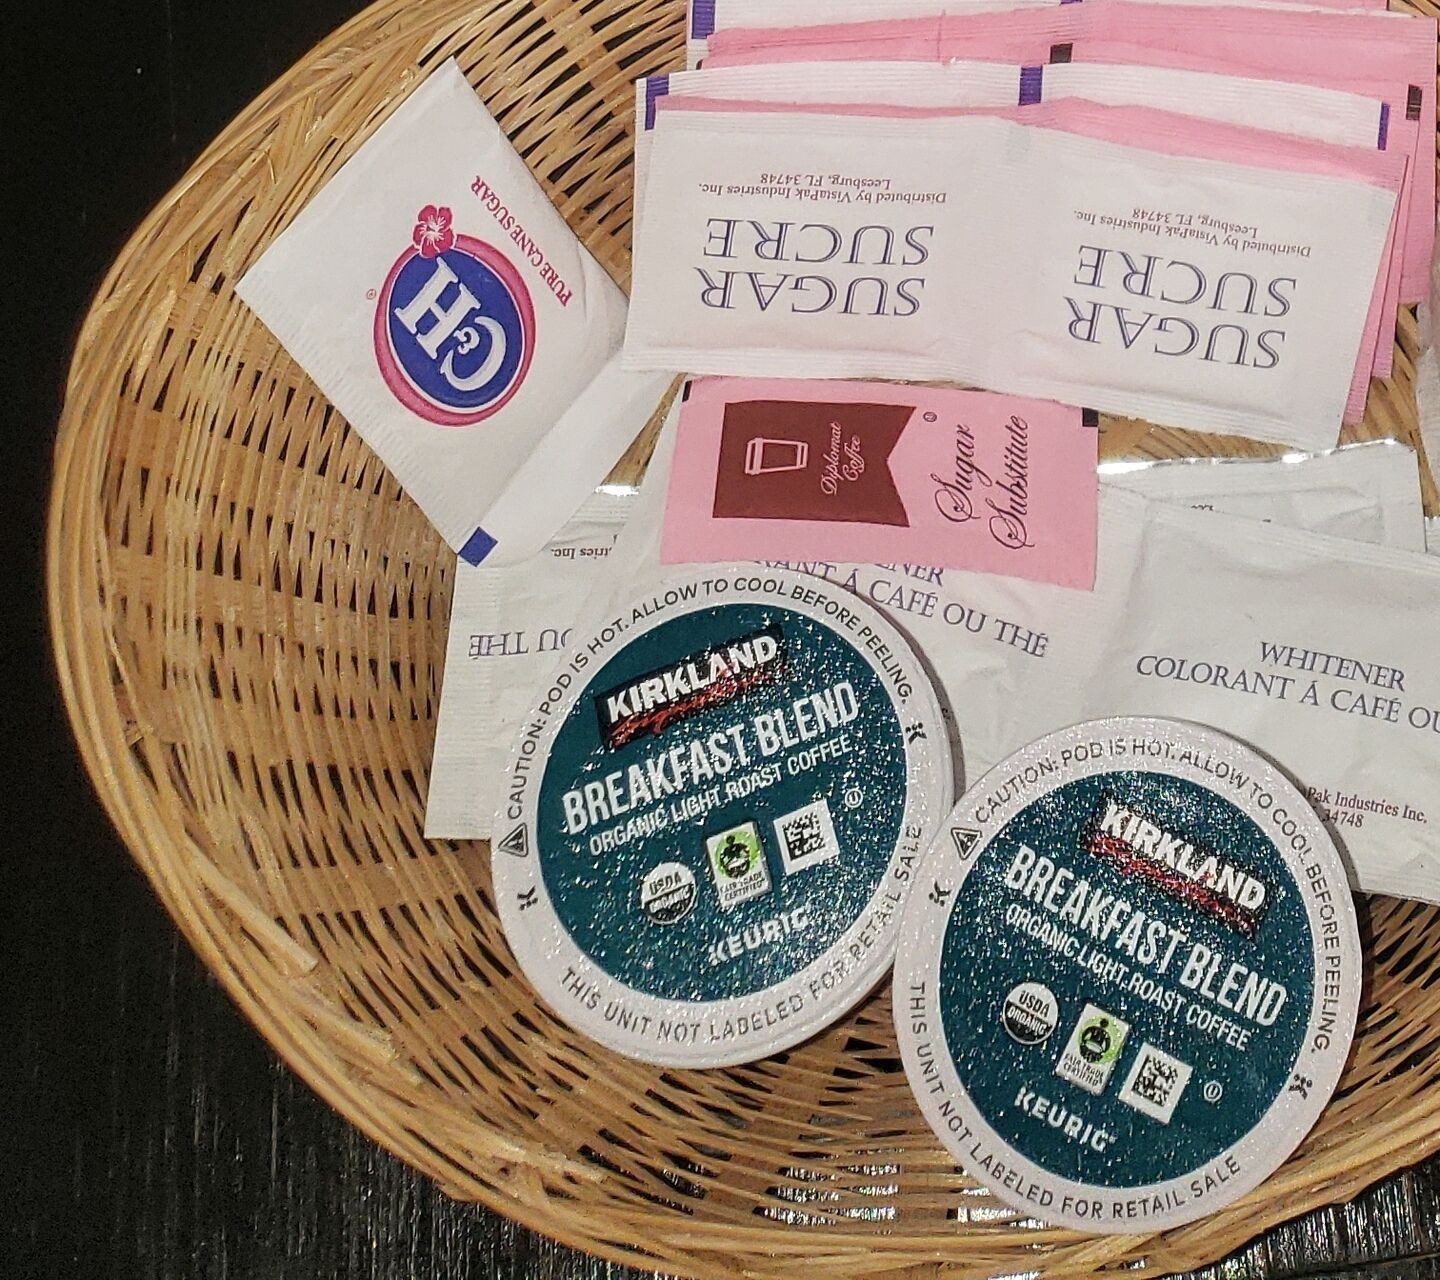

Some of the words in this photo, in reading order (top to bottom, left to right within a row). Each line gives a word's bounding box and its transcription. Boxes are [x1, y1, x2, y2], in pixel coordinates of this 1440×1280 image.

[470, 174, 516, 231] SUGAR
[697, 181, 725, 197] Inc.
[727, 183, 793, 200] Industries
[760, 172, 801, 186] 34748
[795, 188, 853, 204] VistaPak
[803, 173, 824, 188] FL
[855, 190, 874, 205] by
[875, 190, 948, 205] Distributed
[1073, 208, 1097, 226] Inc.
[1099, 215, 1162, 237] Industries
[1131, 208, 1170, 226] 34748
[1165, 224, 1221, 247] VistaPak
[1175, 212, 1195, 227] FL
[509, 224, 545, 268] CANE
[703, 217, 935, 267] SUCRE
[1222, 235, 1240, 252] by
[1242, 239, 1313, 259] Distributed
[539, 261, 573, 307] PURE
[692, 266, 926, 318] SUGAR
[1073, 244, 1298, 318] SUCRE
[394, 255, 507, 392] C&H
[1062, 295, 1287, 370] SUGAR
[820, 421, 844, 497] Diplomat
[842, 433, 865, 481] Coffee
[929, 423, 993, 523] Sugar
[984, 414, 1036, 550] Substitute
[551, 546, 576, 560] Inc.
[868, 579, 939, 619] CAFÉ
[943, 602, 987, 633] OU
[994, 618, 1050, 659] THÉ
[606, 633, 778, 725] KIRKLAND
[1136, 654, 1296, 701] COLORANT
[1330, 689, 1403, 724] CAFÉ
[1259, 641, 1406, 692] WHITENER
[507, 718, 548, 821] CAUTION:
[538, 672, 573, 717] POD
[570, 652, 590, 674] IS
[587, 617, 630, 657] HOT.
[632, 582, 699, 625] ALLOW
[702, 577, 729, 597] TO
[733, 576, 787, 597] COOL
[789, 584, 862, 631] BEFORE
[857, 624, 914, 706] PEELING.
[561, 723, 751, 836] BREAKFAST
[753, 681, 860, 758] BLEND
[1060, 740, 1105, 768] POD
[1108, 738, 1128, 756] IS
[1132, 739, 1177, 761] HOT.
[1179, 749, 1250, 792] ALLOW
[589, 809, 669, 857] ORGANIC
[671, 786, 722, 823] LIGHT
[725, 761, 785, 803] ROAST
[786, 734, 854, 777] COFFEE
[975, 756, 1060, 825] CAUTION:
[1248, 782, 1274, 811] TO
[1334, 791, 1401, 818] Industries
[1402, 804, 1429, 825] Inc.
[1099, 796, 1268, 913] KIRKLAND
[1272, 807, 1315, 862] COOL
[1305, 863, 1341, 951] BEFORE
[559, 966, 602, 1011] THIS
[603, 1000, 653, 1035] UNIT
[656, 1019, 702, 1043] NOT
[709, 993, 805, 1043] LABELED
[808, 958, 854, 1001] FOR
[849, 891, 903, 963] RETAIL
[894, 823, 923, 882] SALE
[707, 907, 812, 966] KEURIG
[1004, 843, 1187, 975] BREAKFAST
[1178, 942, 1288, 1028] BLEND
[1004, 902, 1081, 959] ORGANIC
[1077, 945, 1124, 984] LIGHT
[1127, 971, 1188, 1018] ROAST
[1185, 1002, 1254, 1052] COFFEE
[909, 981, 929, 1036] THIS
[1006, 1006, 1048, 1036] ORGANIC
[1018, 988, 1052, 1019] USDA
[1311, 954, 1342, 1055] PEELING.
[916, 1041, 946, 1095] UNIT
[937, 1099, 974, 1143] NOT
[1013, 1085, 1113, 1153] KEURIG
[968, 1141, 1054, 1208] LABELED
[1189, 1154, 1242, 1200] SALE
[1060, 1196, 1105, 1220] FOR
[1112, 1190, 1187, 1220] RETAIL
